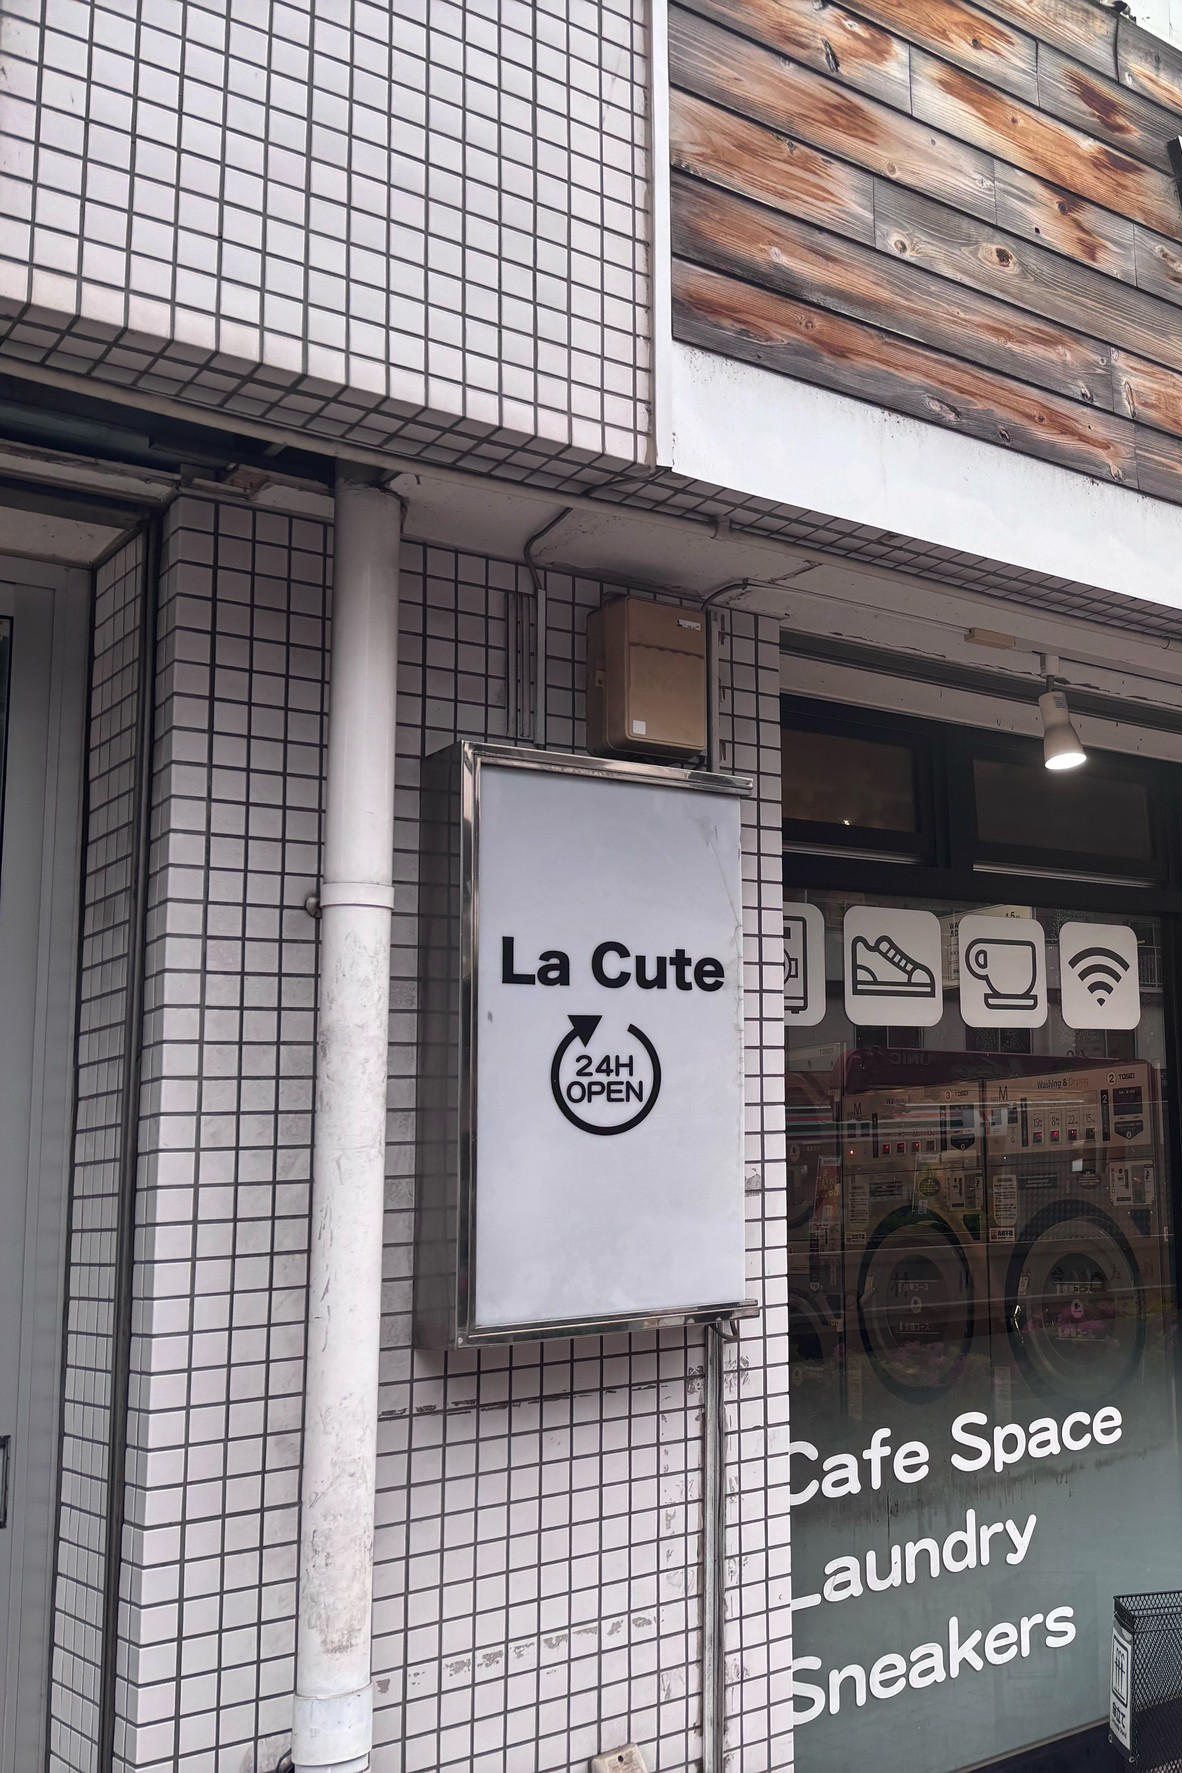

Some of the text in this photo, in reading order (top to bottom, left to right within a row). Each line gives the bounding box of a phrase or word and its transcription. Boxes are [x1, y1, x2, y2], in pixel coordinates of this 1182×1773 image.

[502, 936, 726, 993] La Cute
[566, 1080, 644, 1104] OPEN
[575, 1054, 634, 1077] 24H
[950, 1405, 1123, 1473] Space
[792, 1606, 1077, 1726] Sneakers
